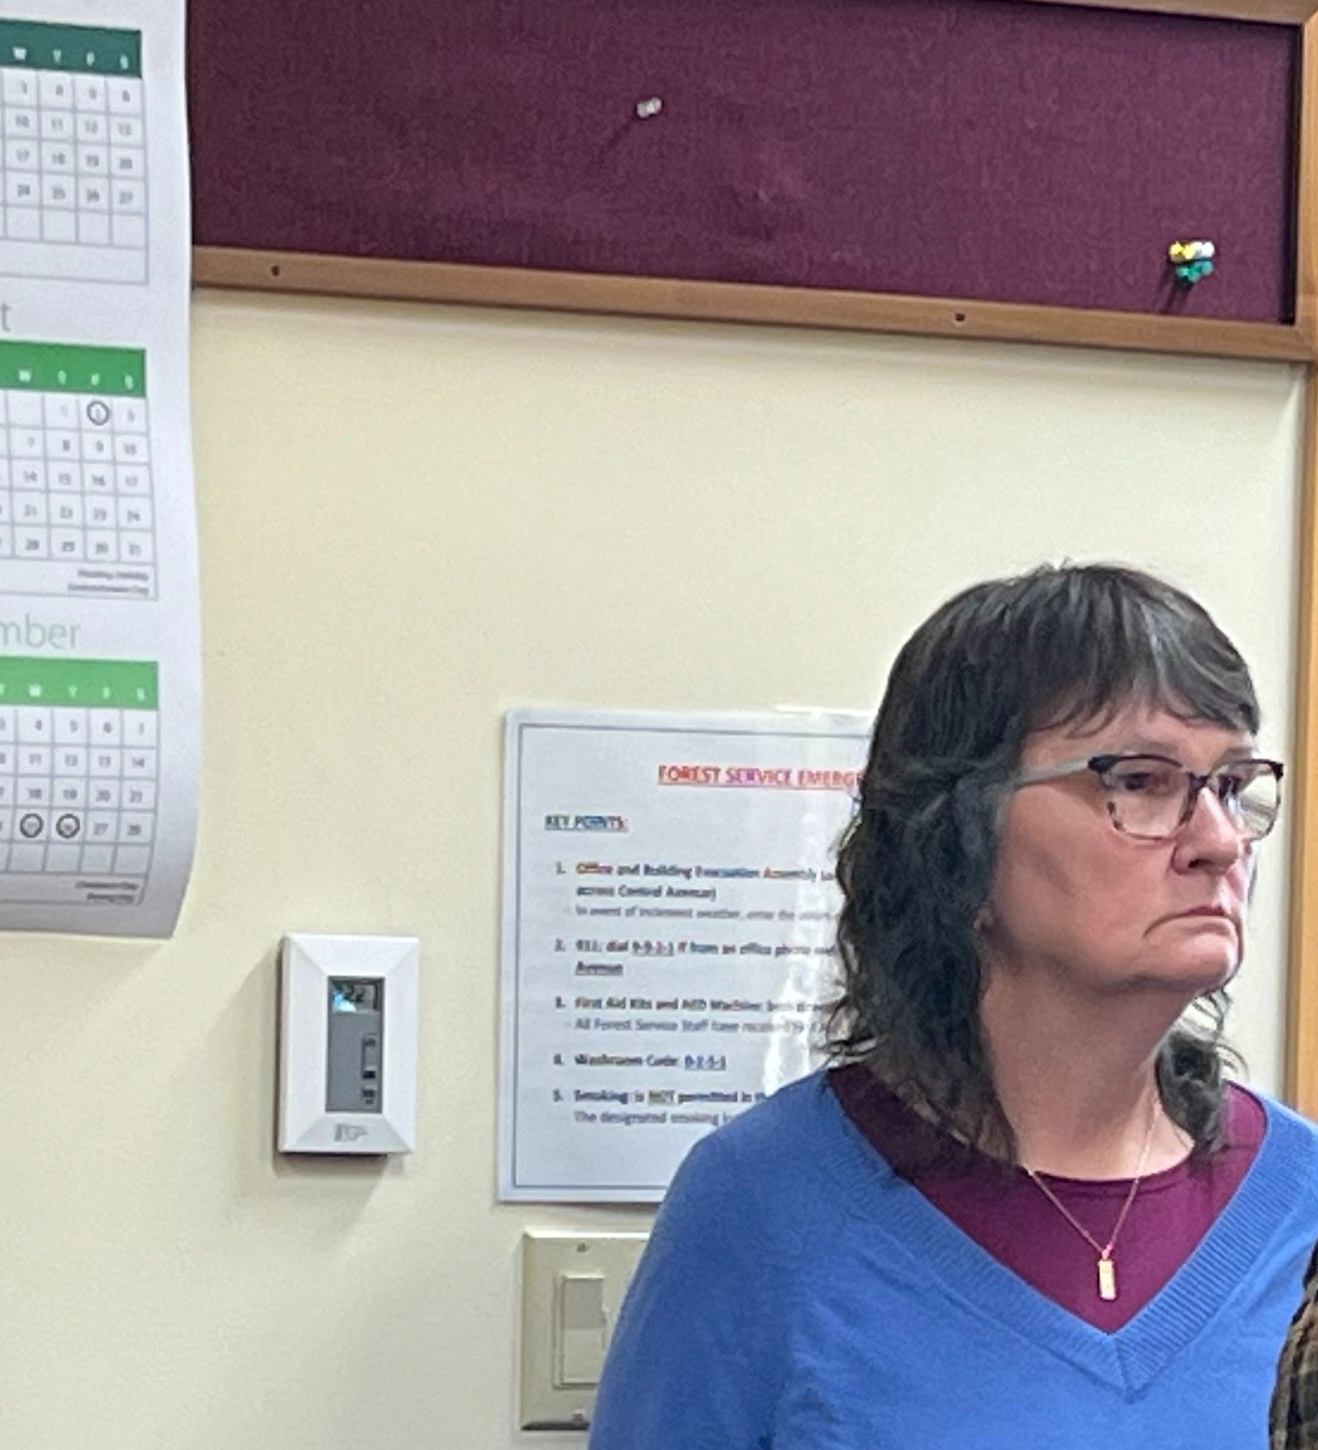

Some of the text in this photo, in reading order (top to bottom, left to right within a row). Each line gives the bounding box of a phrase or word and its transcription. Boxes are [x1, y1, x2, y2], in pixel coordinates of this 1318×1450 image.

[658, 765, 720, 783] FOREST
[726, 767, 791, 785] SERVICE
[545, 815, 570, 829] KEY
